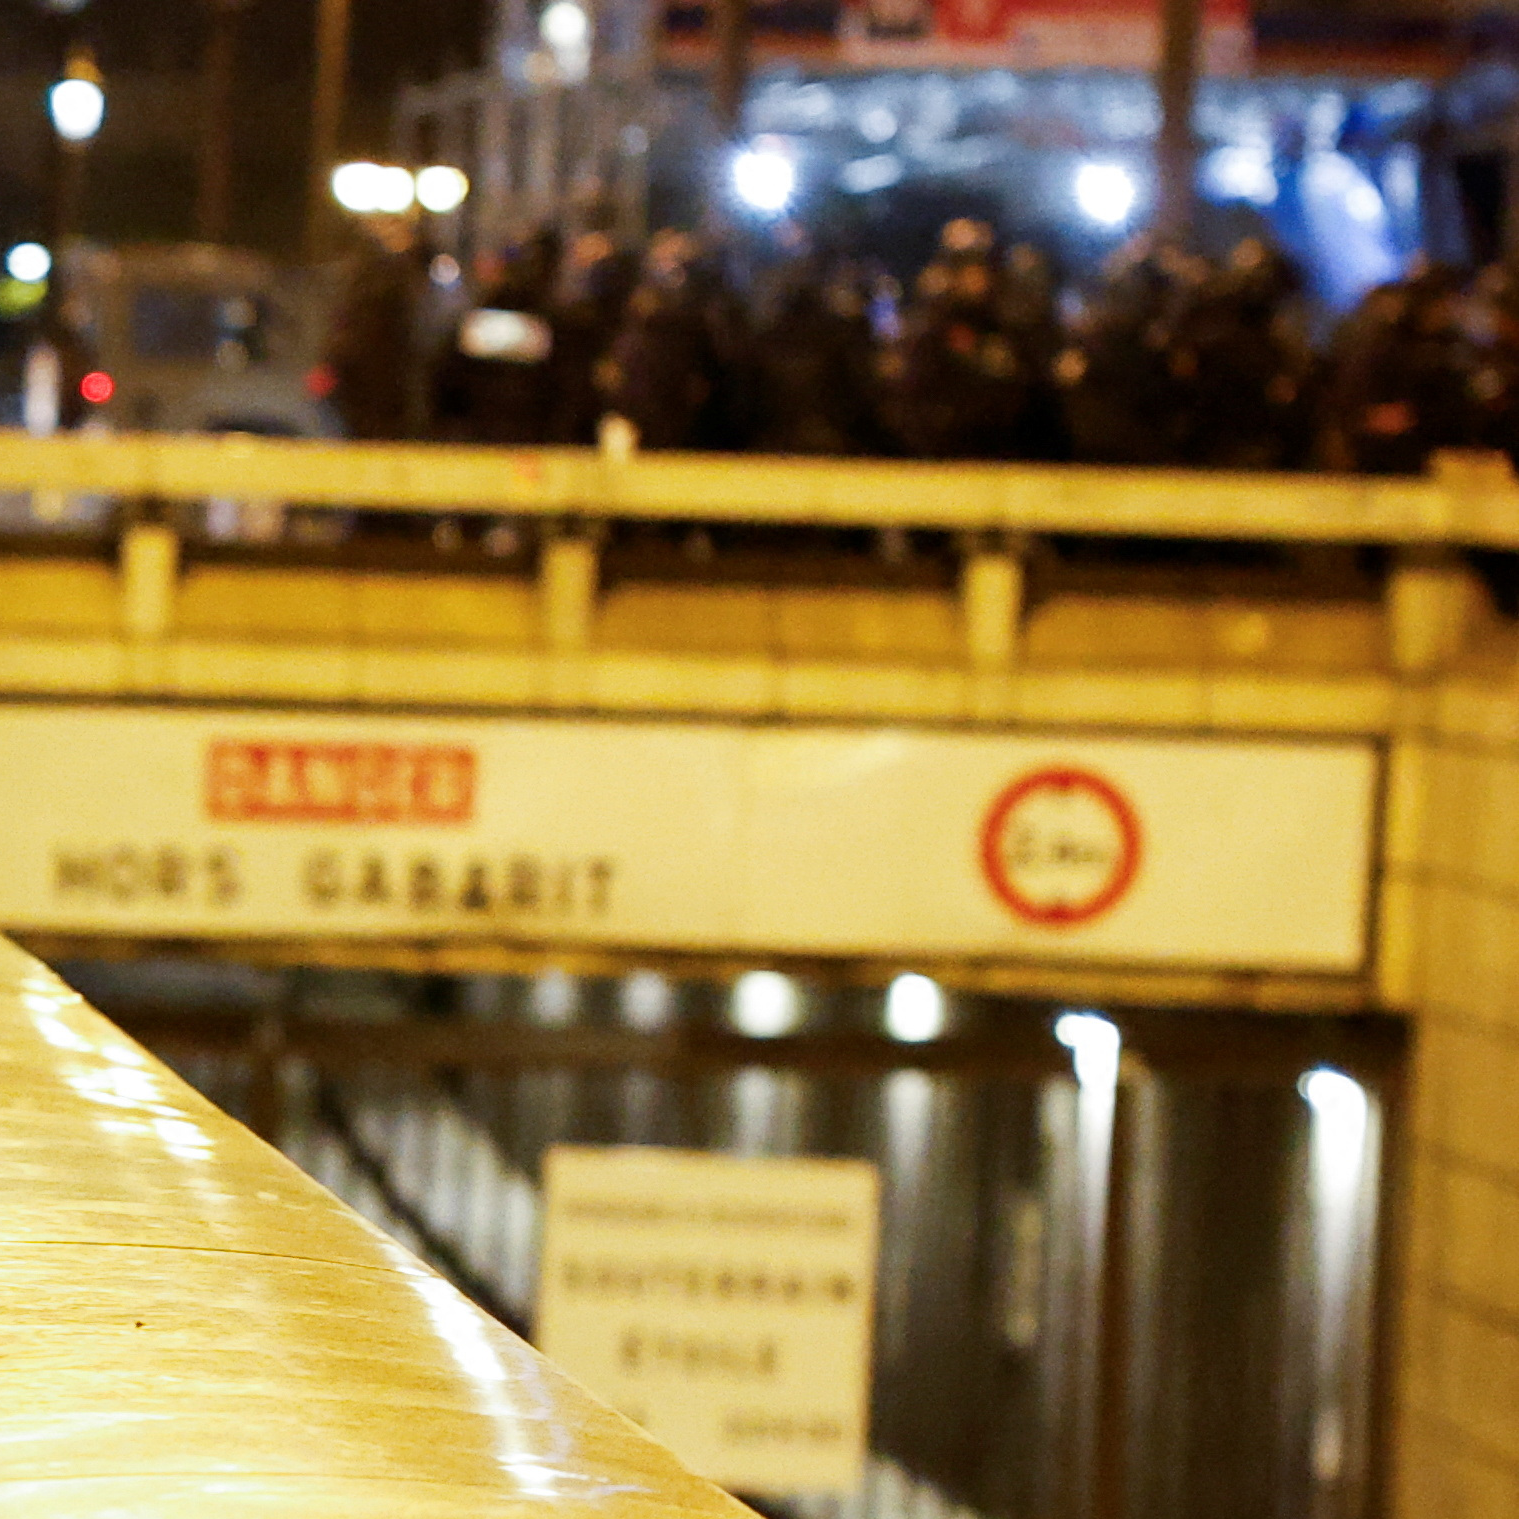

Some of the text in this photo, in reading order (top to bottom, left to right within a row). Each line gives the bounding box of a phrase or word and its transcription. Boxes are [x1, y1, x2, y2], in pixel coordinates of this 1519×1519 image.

[215, 750, 467, 808] DANGER
[54, 845, 614, 914] HORS GABARIT
